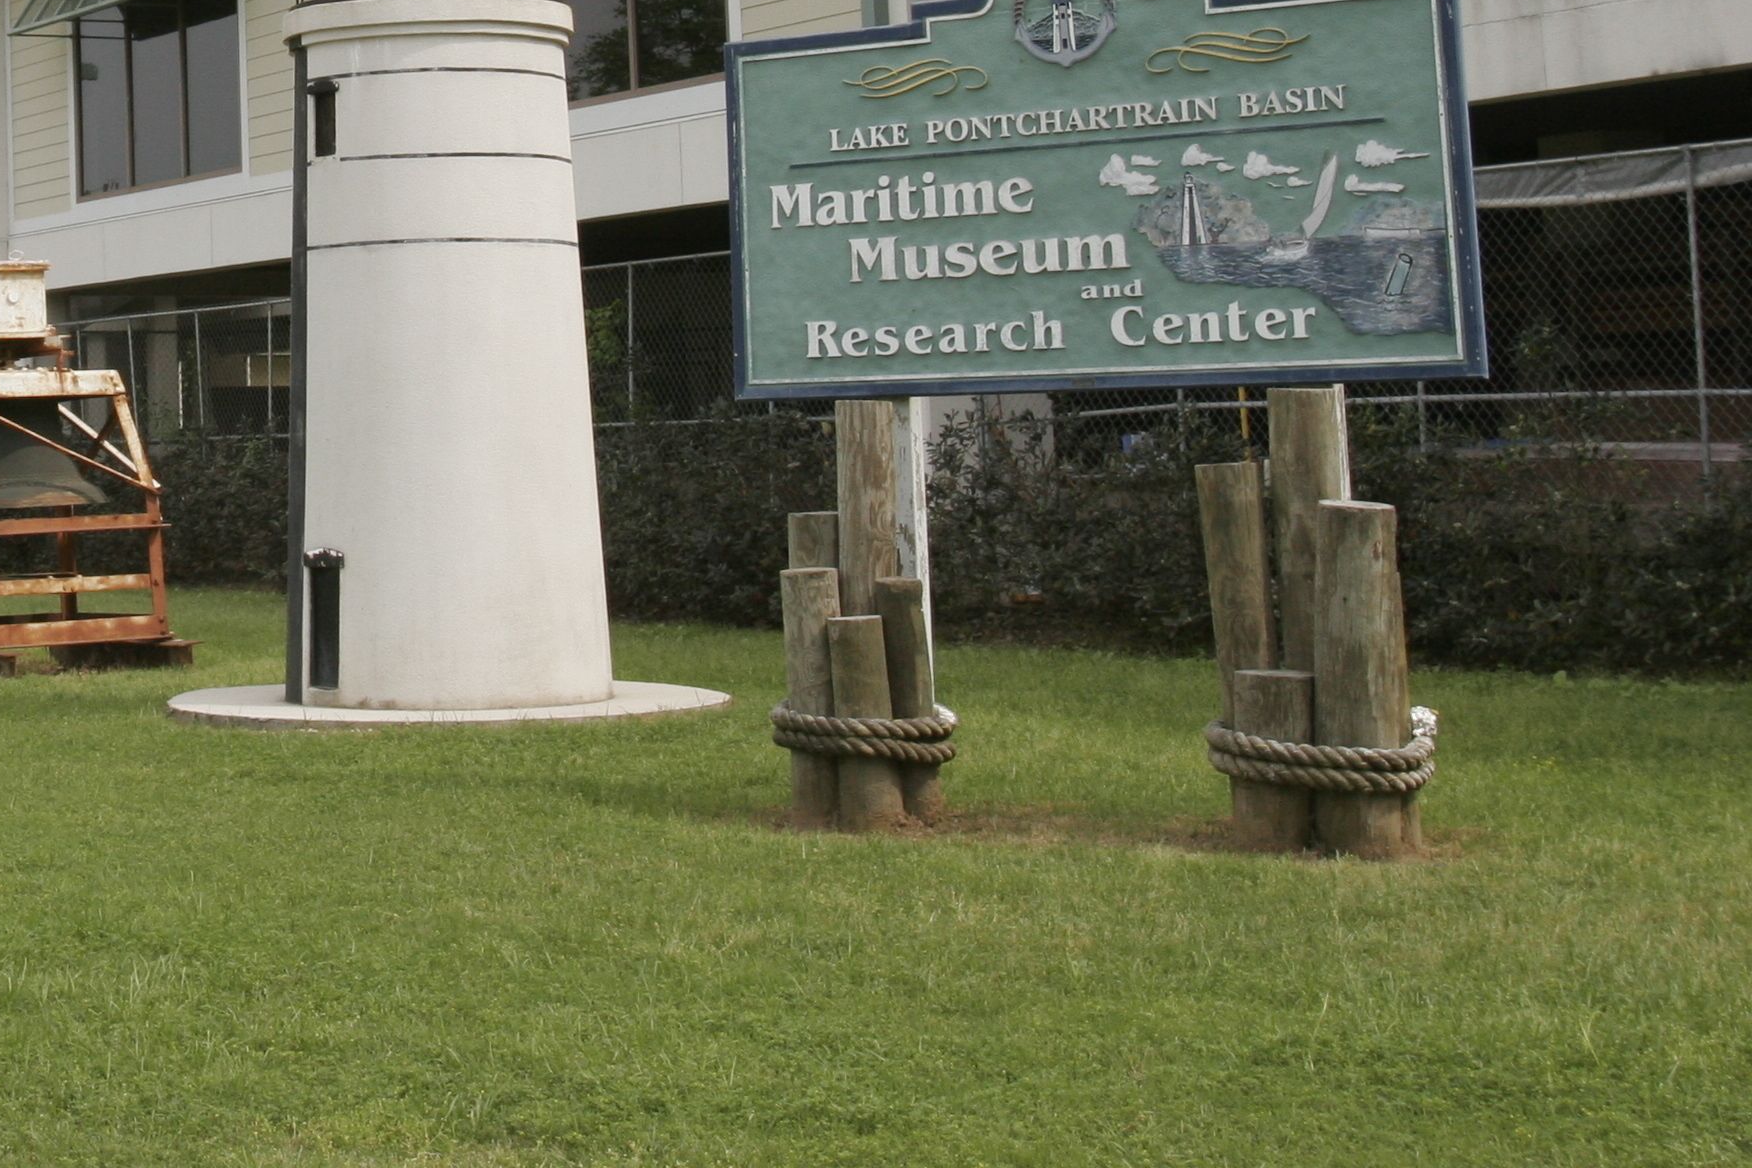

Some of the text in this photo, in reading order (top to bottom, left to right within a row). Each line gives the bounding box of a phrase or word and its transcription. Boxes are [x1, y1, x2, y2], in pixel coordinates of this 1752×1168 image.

[829, 84, 1346, 152] LAKE PONTCHARTRAIN BASIN
[769, 171, 1034, 230] Maritime
[848, 234, 1131, 283] Museum
[1081, 279, 1144, 299] and
[805, 300, 1316, 360] Research Center
